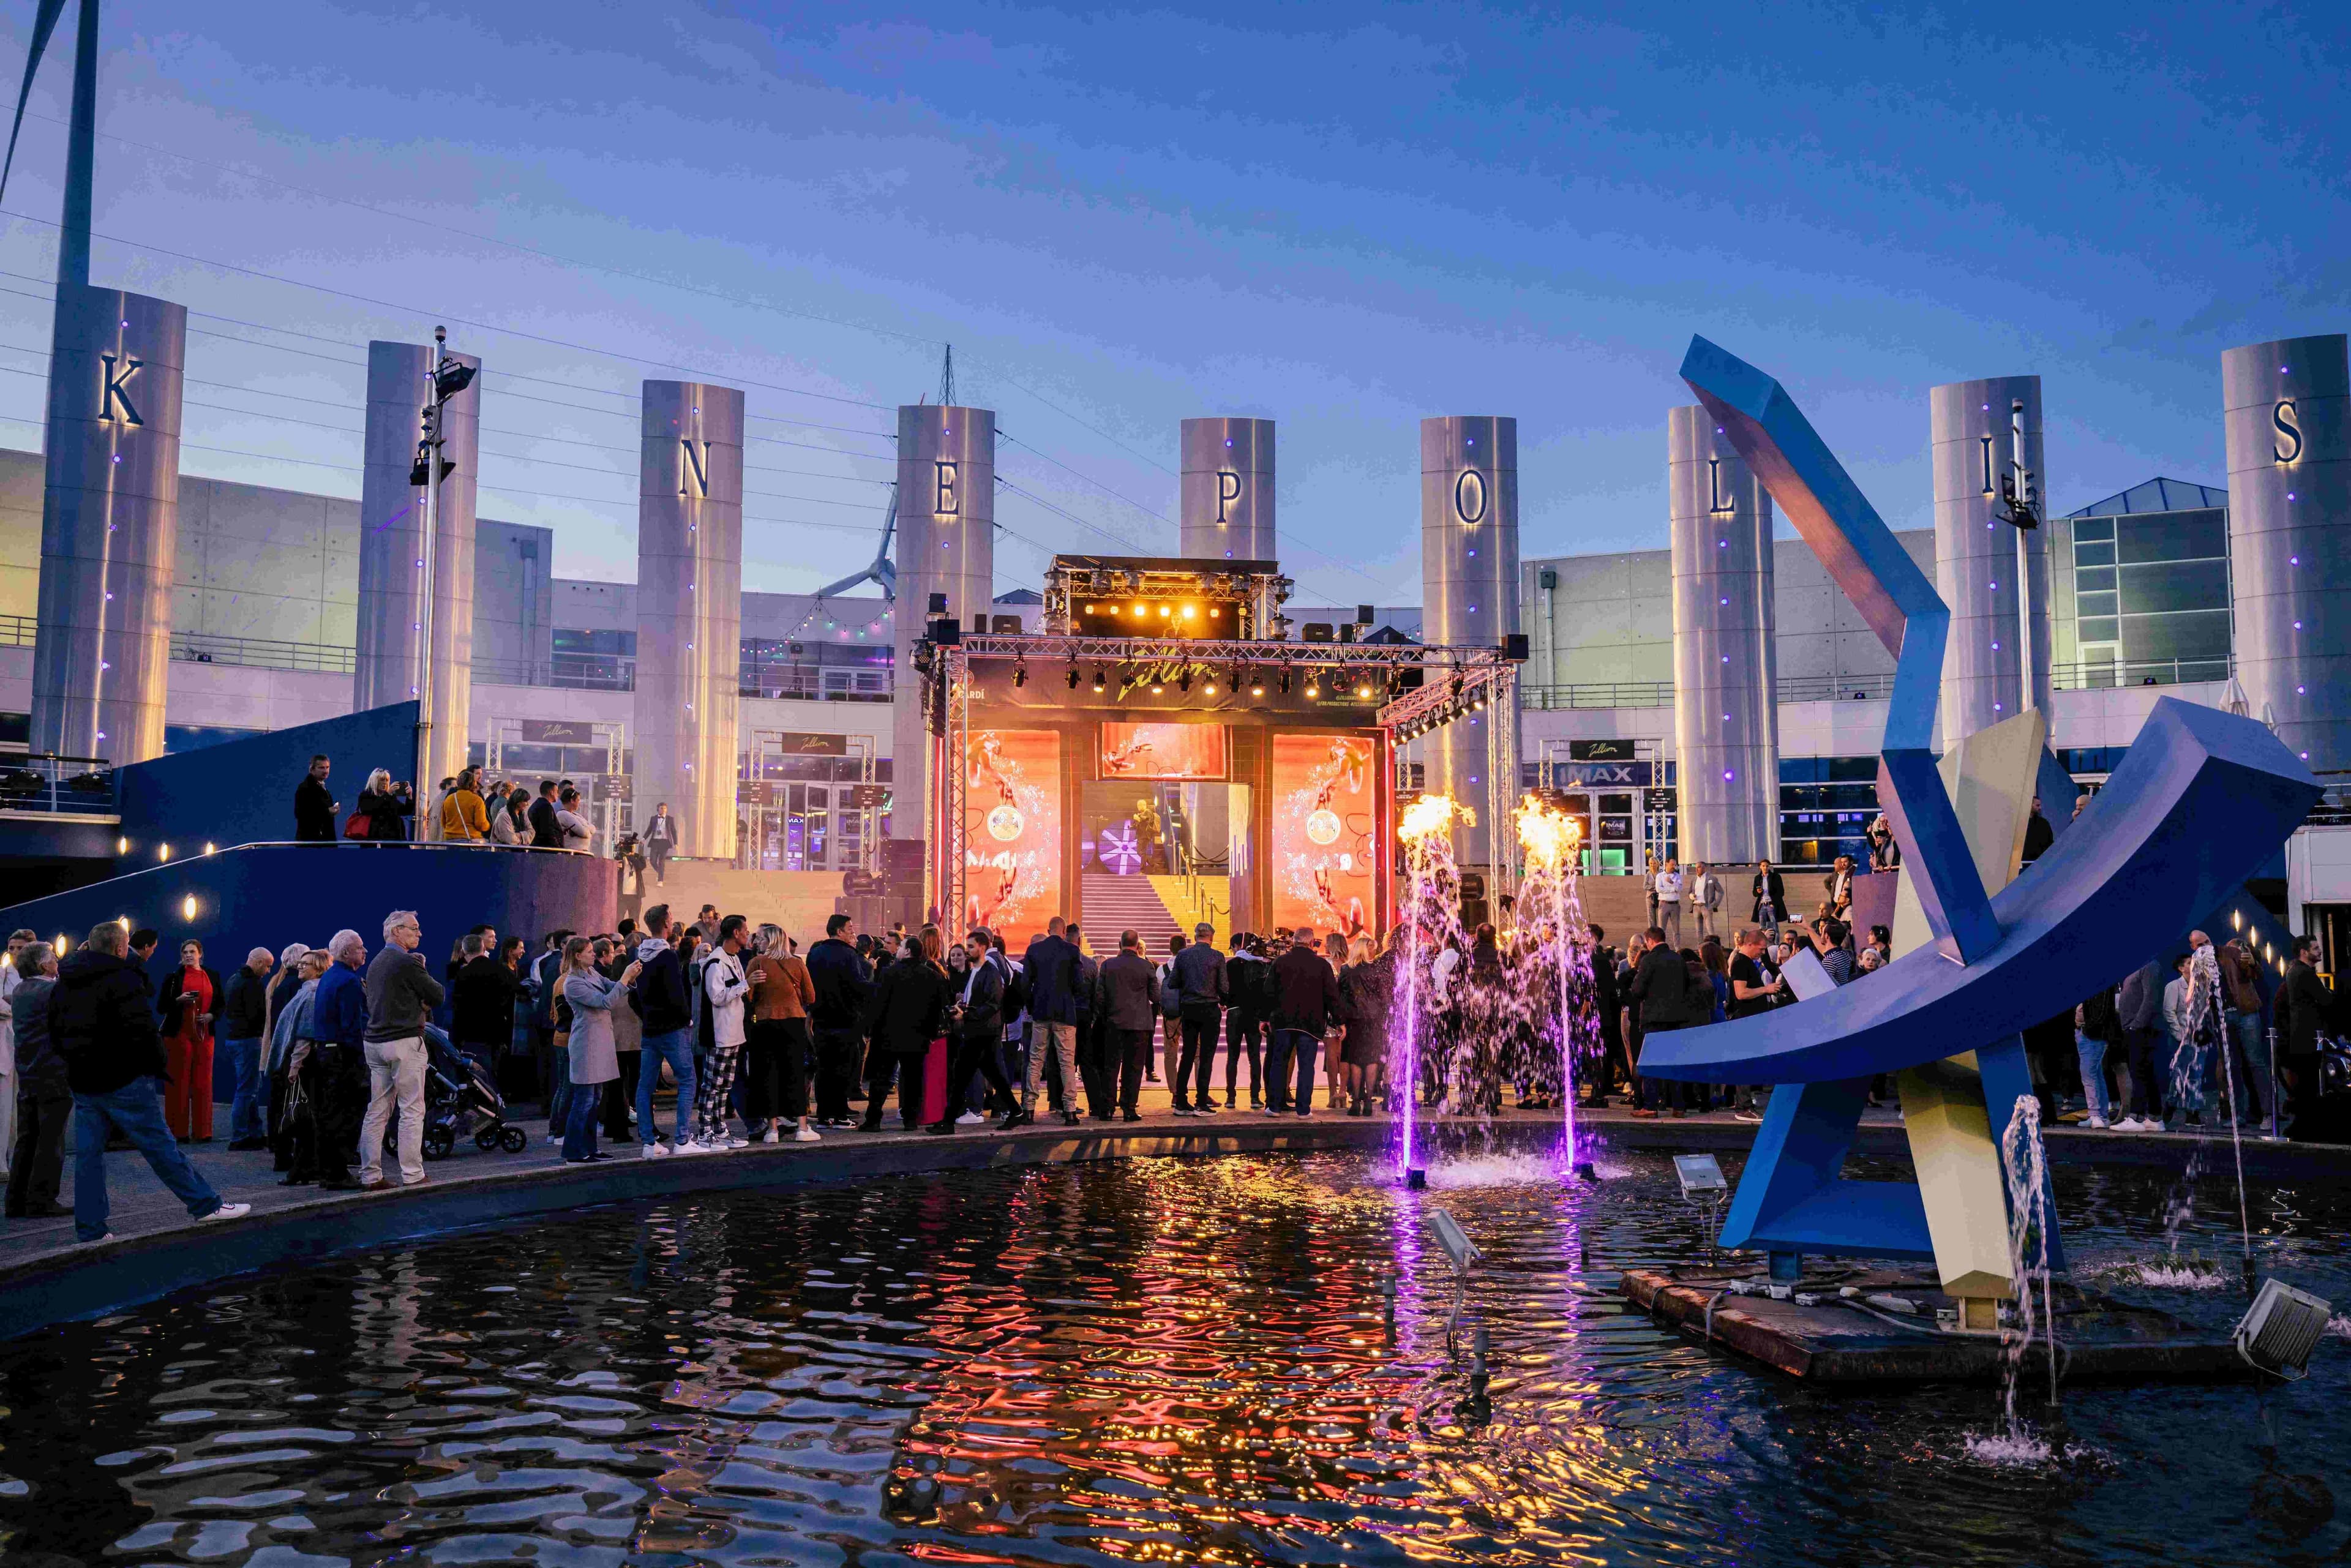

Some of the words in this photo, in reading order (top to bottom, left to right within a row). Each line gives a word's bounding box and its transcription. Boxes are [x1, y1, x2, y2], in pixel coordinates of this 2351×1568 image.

[98, 355, 144, 426] K
[679, 439, 711, 497] N
[934, 460, 959, 515] E
[1216, 471, 1241, 523] P
[1455, 469, 1487, 524] O
[1709, 459, 1734, 513] L
[1981, 437, 1994, 493] I
[2273, 400, 2302, 463] S
[542, 724, 574, 740] Zillion
[800, 736, 830, 751] Zillion
[1588, 743, 1618, 758] Zillion
[1560, 767, 1633, 782] IMAX
